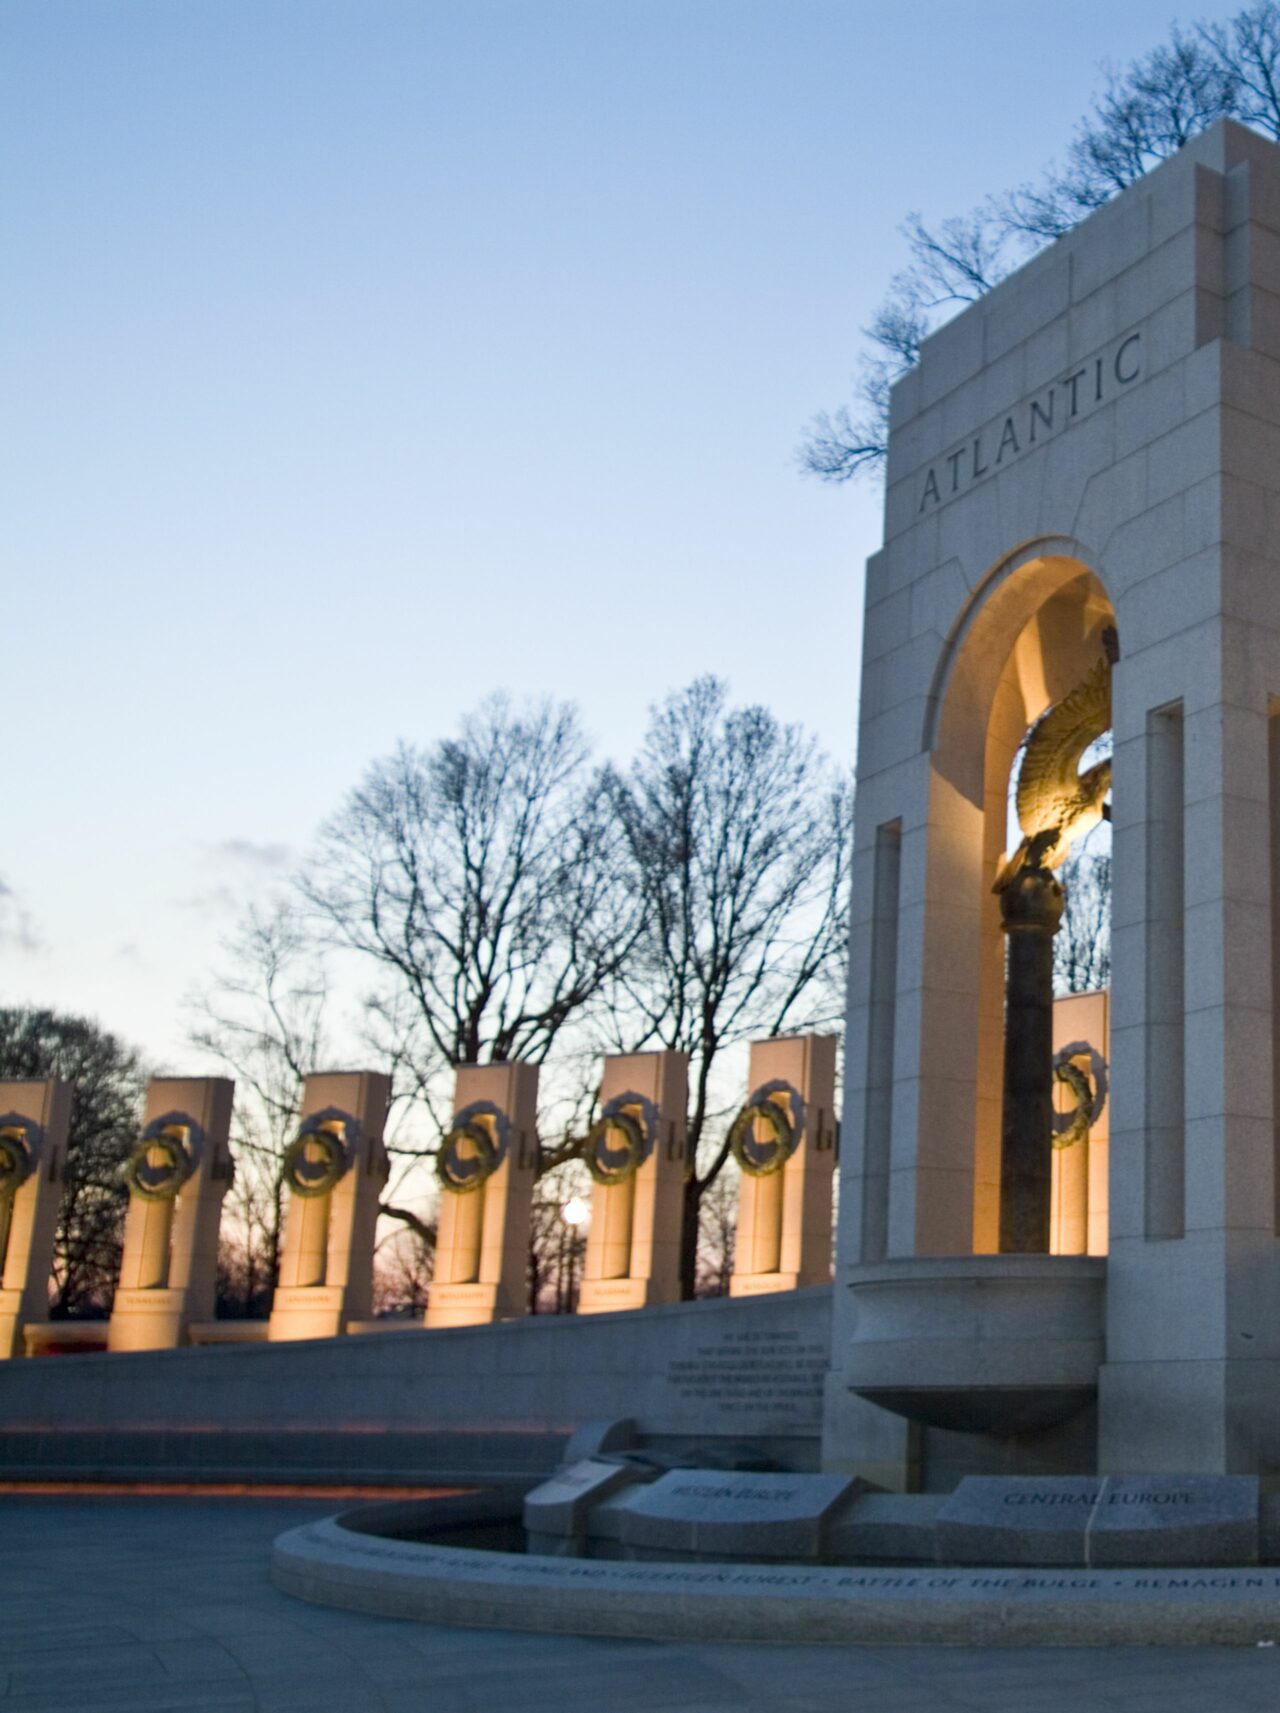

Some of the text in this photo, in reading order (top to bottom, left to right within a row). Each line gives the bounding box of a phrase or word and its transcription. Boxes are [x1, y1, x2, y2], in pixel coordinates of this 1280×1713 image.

[918, 332, 1142, 513] ATLANTIC
[1003, 1492, 1195, 1505] CENTRAL EUROPE
[836, 1577, 923, 1588] BATTLE
[928, 1577, 965, 1588] OF
[969, 1577, 1018, 1588] THE
[1020, 1577, 1101, 1588] BULGE
[1134, 1577, 1264, 1589] REMAGEN
